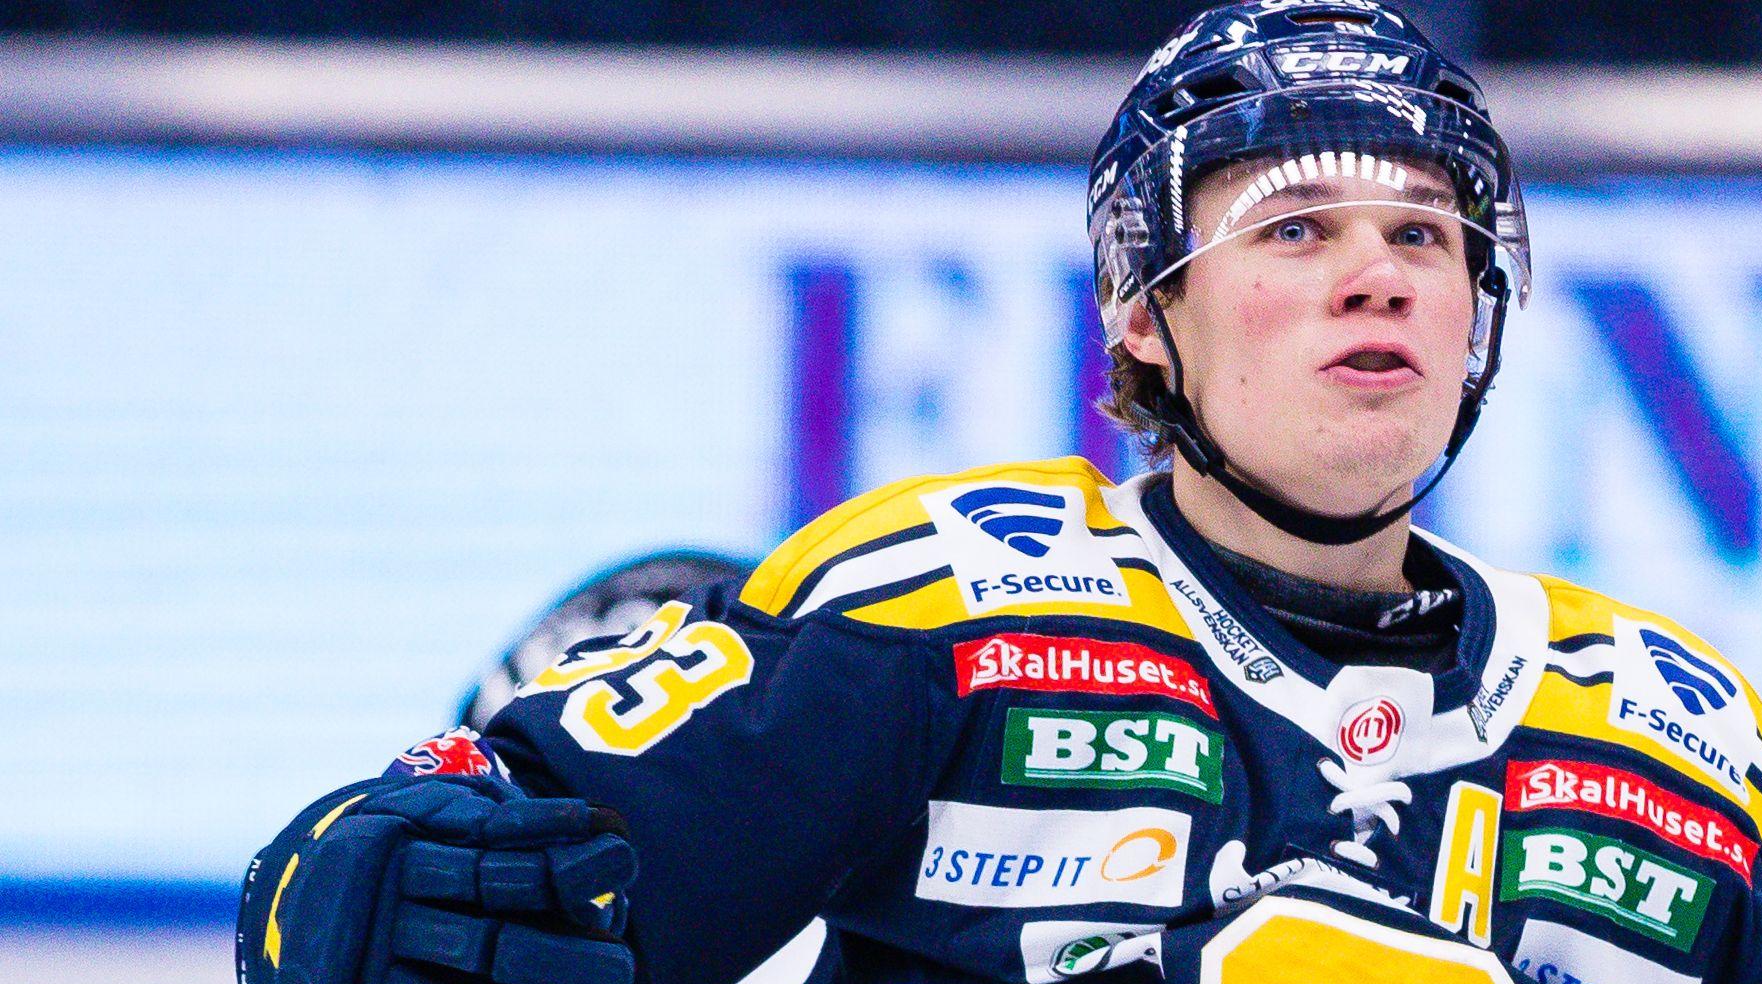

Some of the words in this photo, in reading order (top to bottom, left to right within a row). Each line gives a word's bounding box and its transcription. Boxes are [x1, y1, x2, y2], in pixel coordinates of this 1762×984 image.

[1281, 52, 1409, 74] CCM
[1169, 579, 1250, 666] ALLSVENSKAN
[1212, 608, 1263, 654] HOCKEY
[1025, 714, 1210, 776] BST
[1429, 780, 1503, 950] A
[1518, 832, 1699, 926] BST
